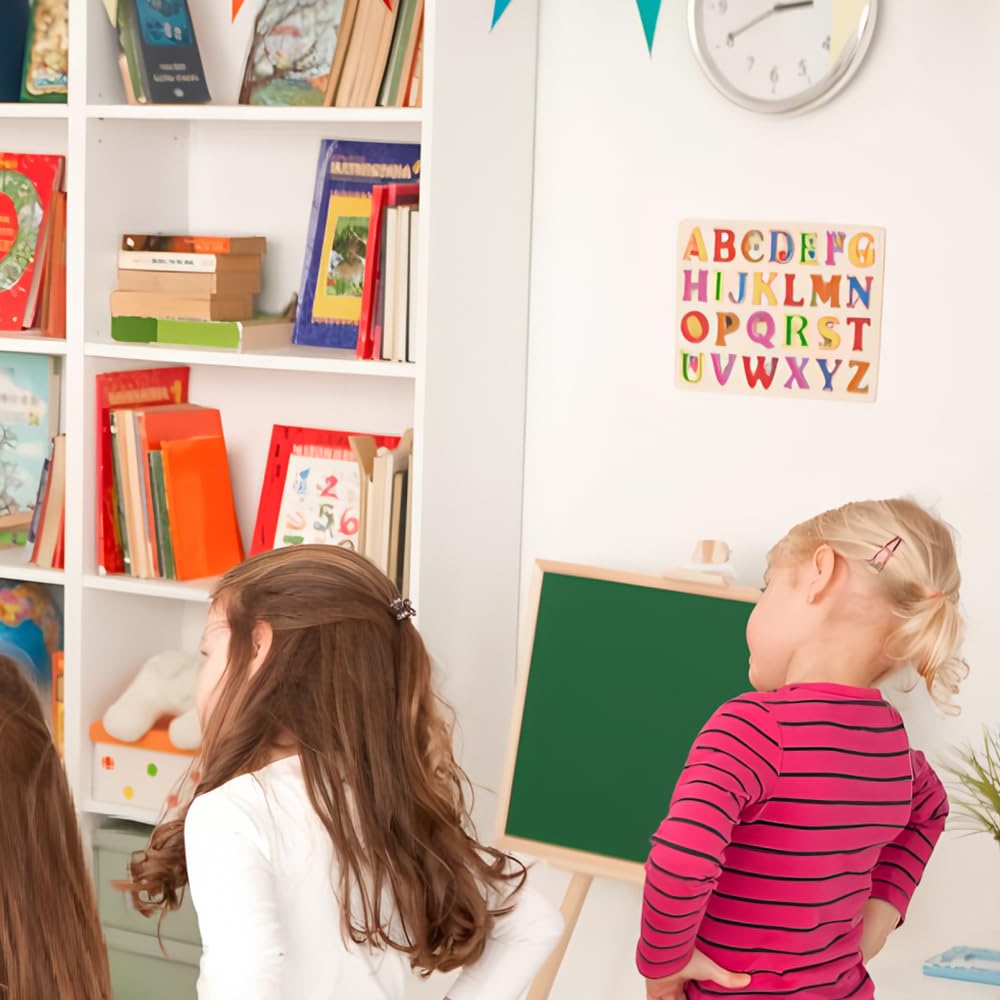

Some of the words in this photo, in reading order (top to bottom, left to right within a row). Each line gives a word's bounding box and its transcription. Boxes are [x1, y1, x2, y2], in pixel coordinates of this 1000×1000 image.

[320, 474, 339, 500] 2
[313, 503, 335, 533] 5
[339, 507, 360, 536] 6
